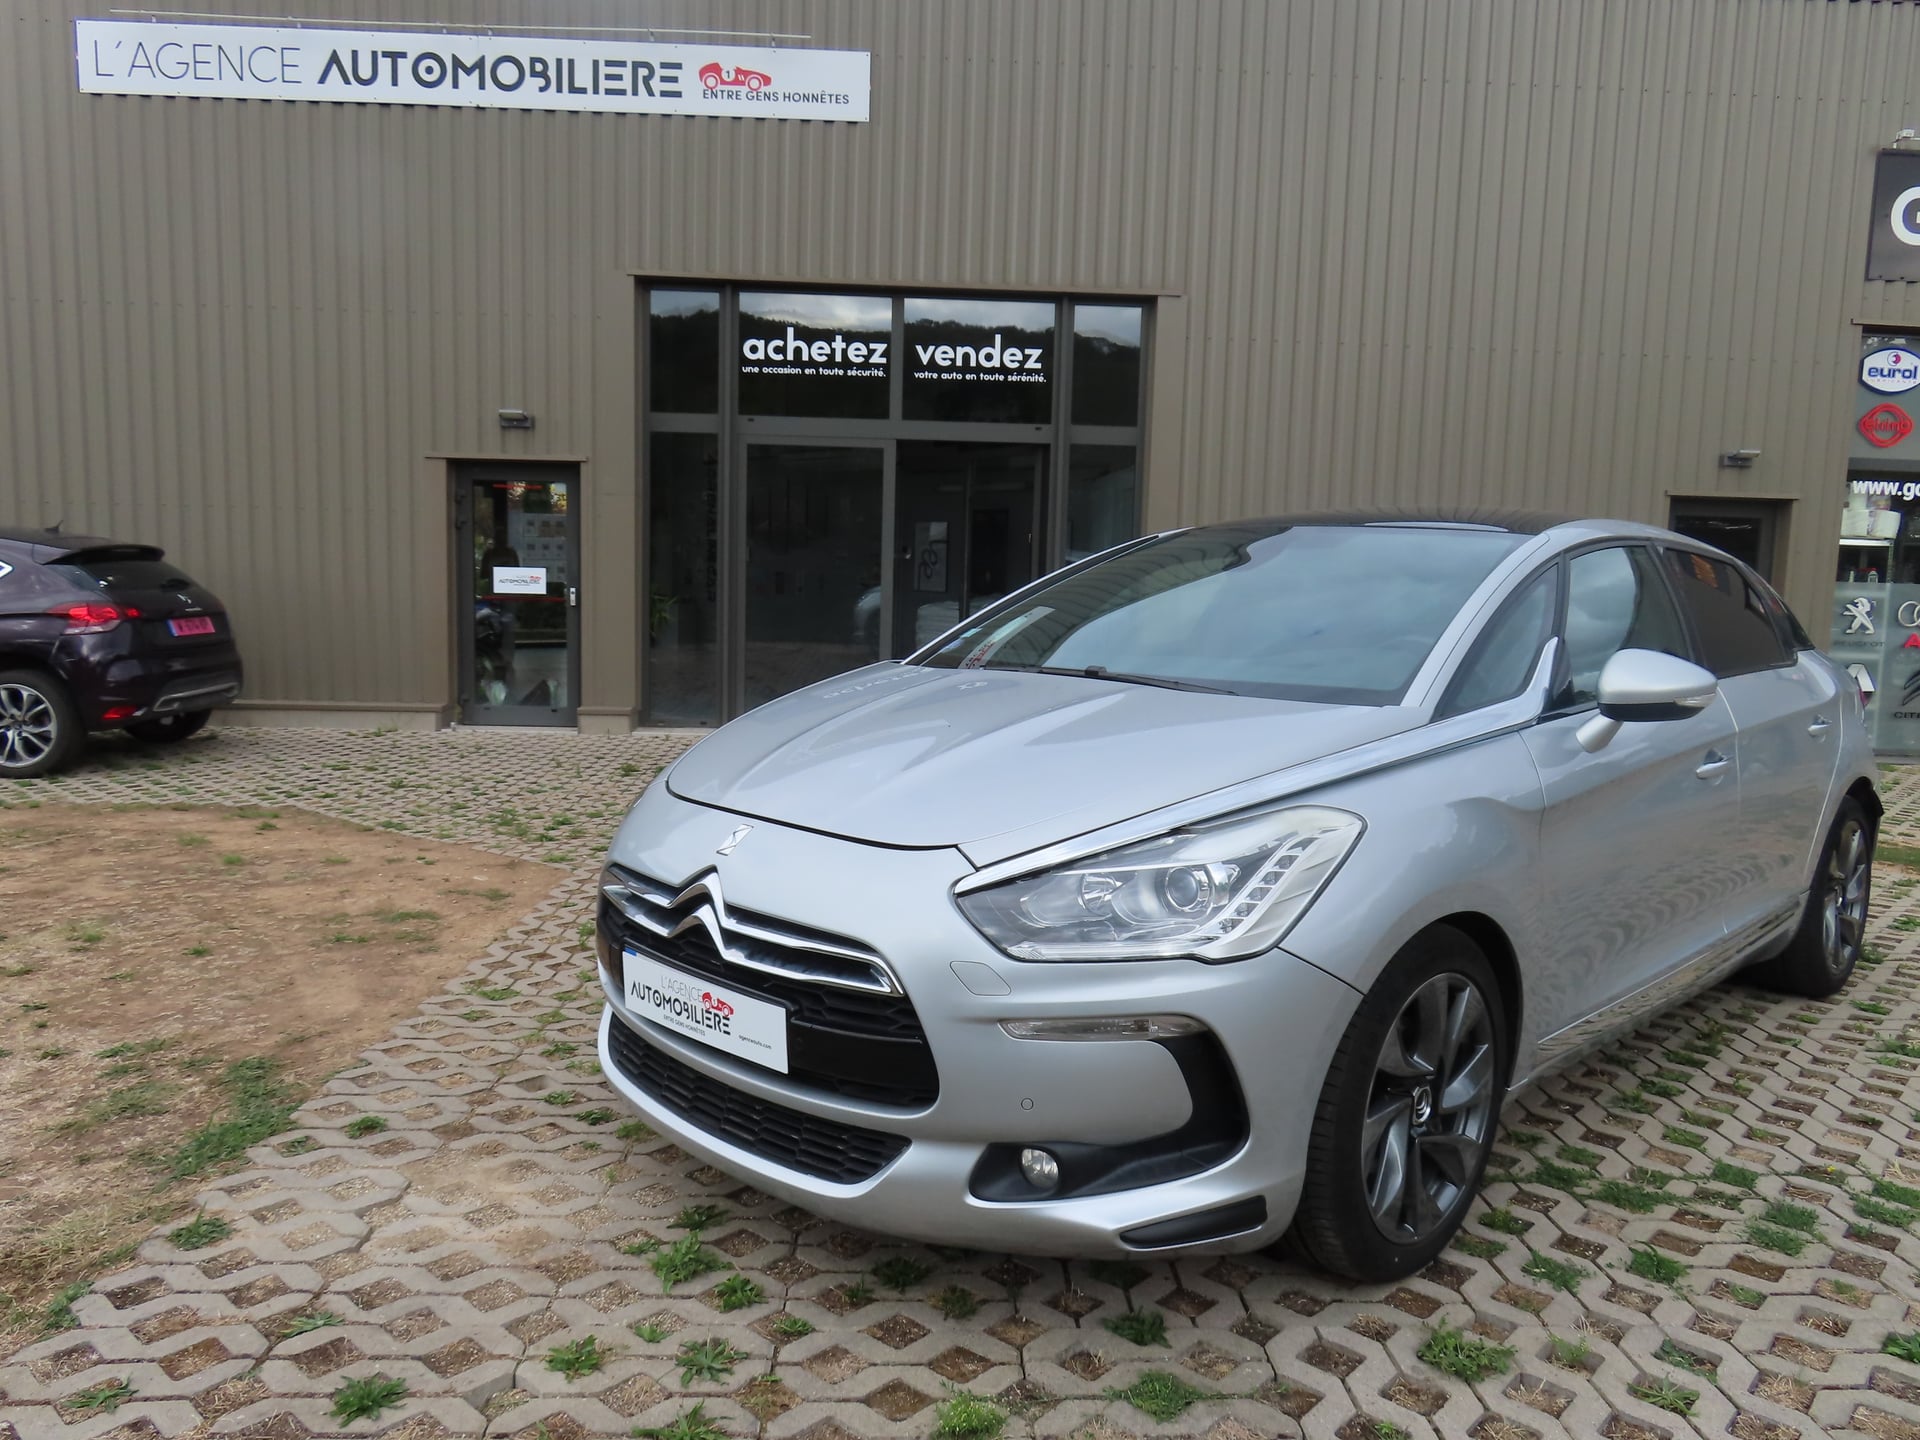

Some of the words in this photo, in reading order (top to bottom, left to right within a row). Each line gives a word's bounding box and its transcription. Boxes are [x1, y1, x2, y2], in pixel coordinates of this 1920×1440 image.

[317, 49, 683, 98] AUTOMOBILIERE
[702, 88, 742, 101] ENTRE
[746, 90, 779, 102] GENS
[783, 89, 850, 105] HONNÊTES
[742, 326, 888, 364] achetez
[915, 333, 1043, 370] vendez
[742, 365, 760, 374] une
[762, 365, 801, 375] occasion
[804, 366, 816, 375] en
[819, 366, 844, 376] toute
[847, 366, 887, 378] sécurité.
[914, 370, 938, 379] votre
[941, 371, 963, 380] auto
[979, 372, 1005, 381] toute
[1007, 371, 1047, 383] sérénité.
[1868, 365, 1919, 380] eurol
[630, 980, 731, 1036] AUTOMOBILIERE
